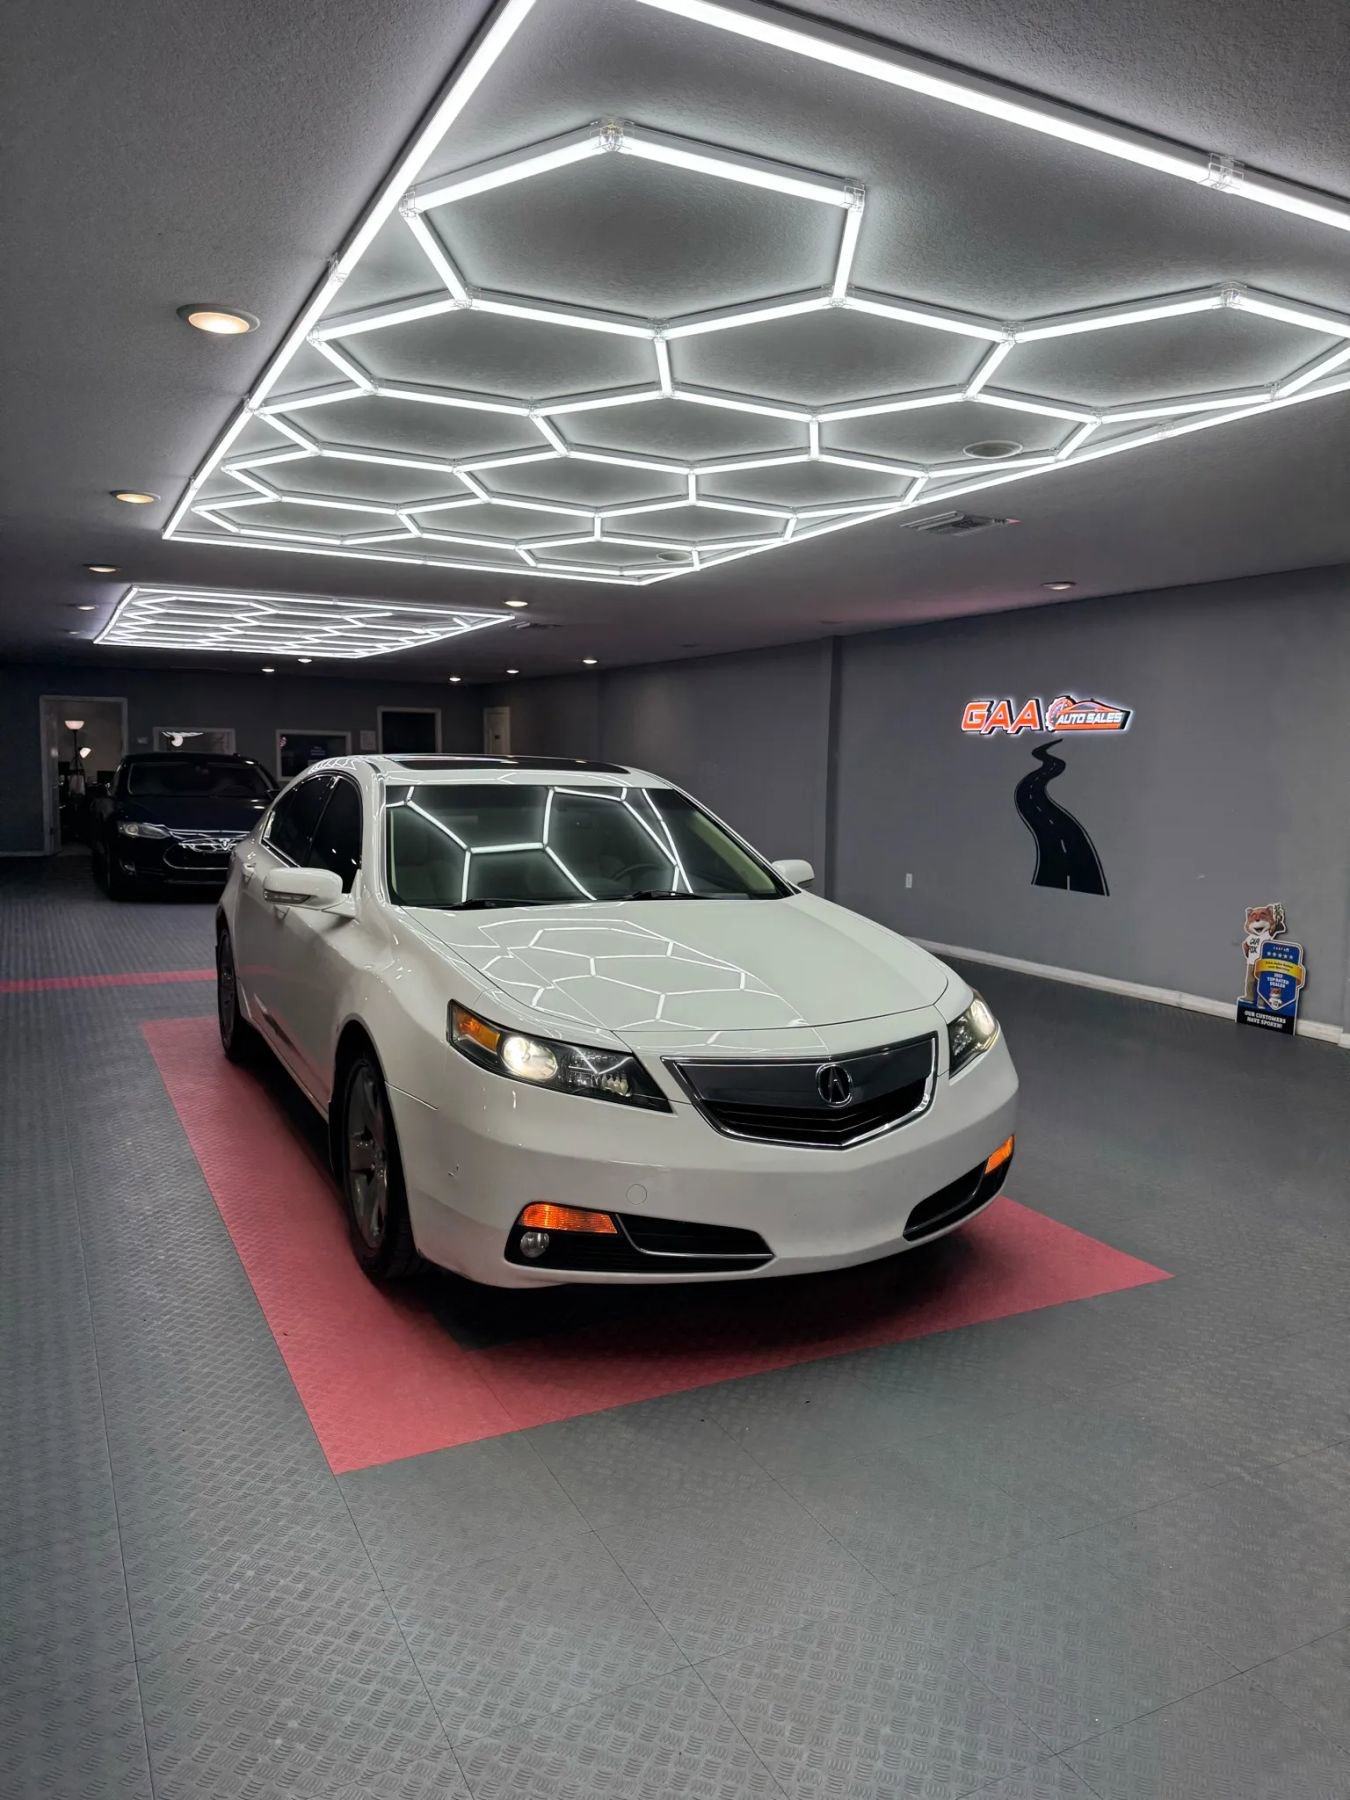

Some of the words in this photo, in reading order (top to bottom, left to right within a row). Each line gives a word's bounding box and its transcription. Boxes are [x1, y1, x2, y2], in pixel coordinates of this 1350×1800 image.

[962, 698, 1041, 734] GAA
[1058, 713, 1086, 724] AUTO
[1087, 712, 1122, 723] SALES
[1256, 1013, 1286, 1024] CUSTOMERS
